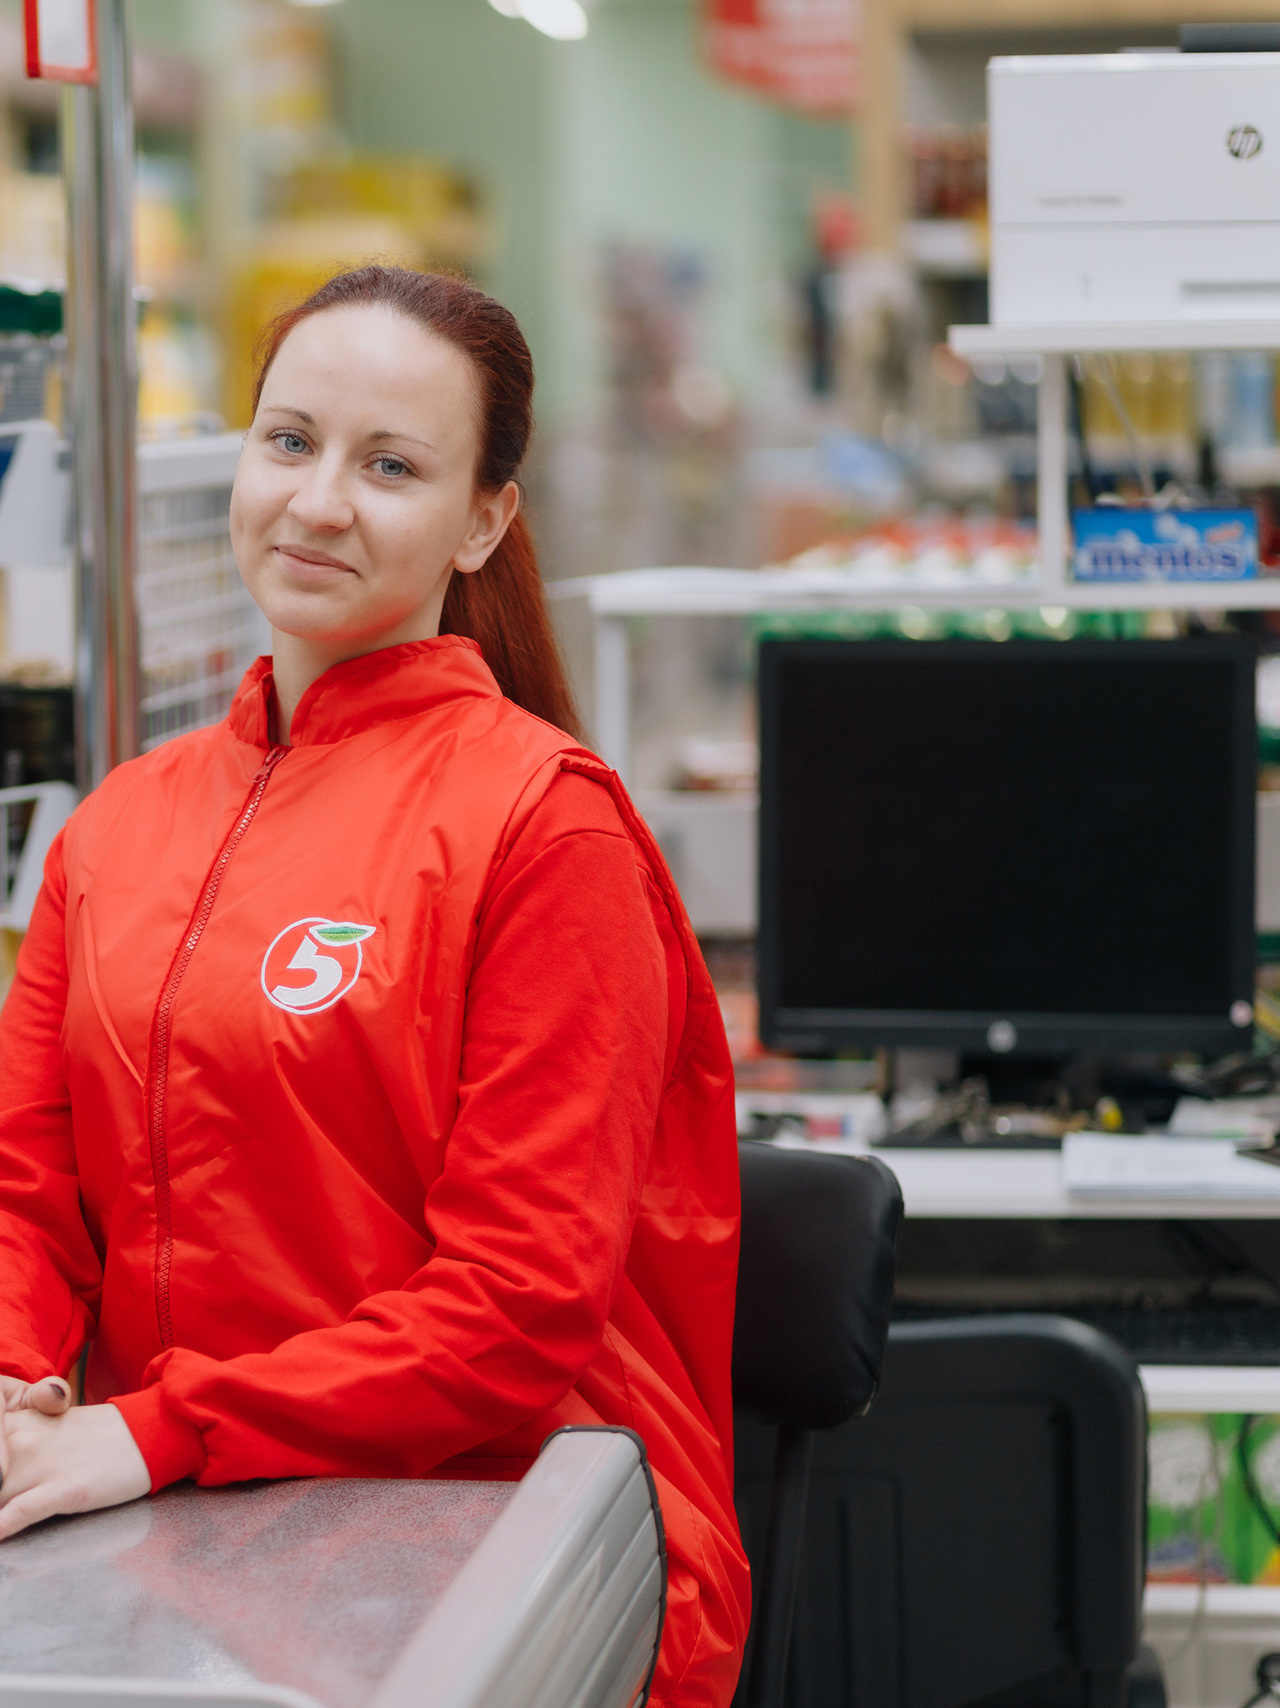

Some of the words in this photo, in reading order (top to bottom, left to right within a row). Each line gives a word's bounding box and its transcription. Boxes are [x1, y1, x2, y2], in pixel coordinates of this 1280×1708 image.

[1228, 124, 1262, 159] hp
[1088, 545, 1240, 572] mentos
[271, 935, 343, 1006] 5
